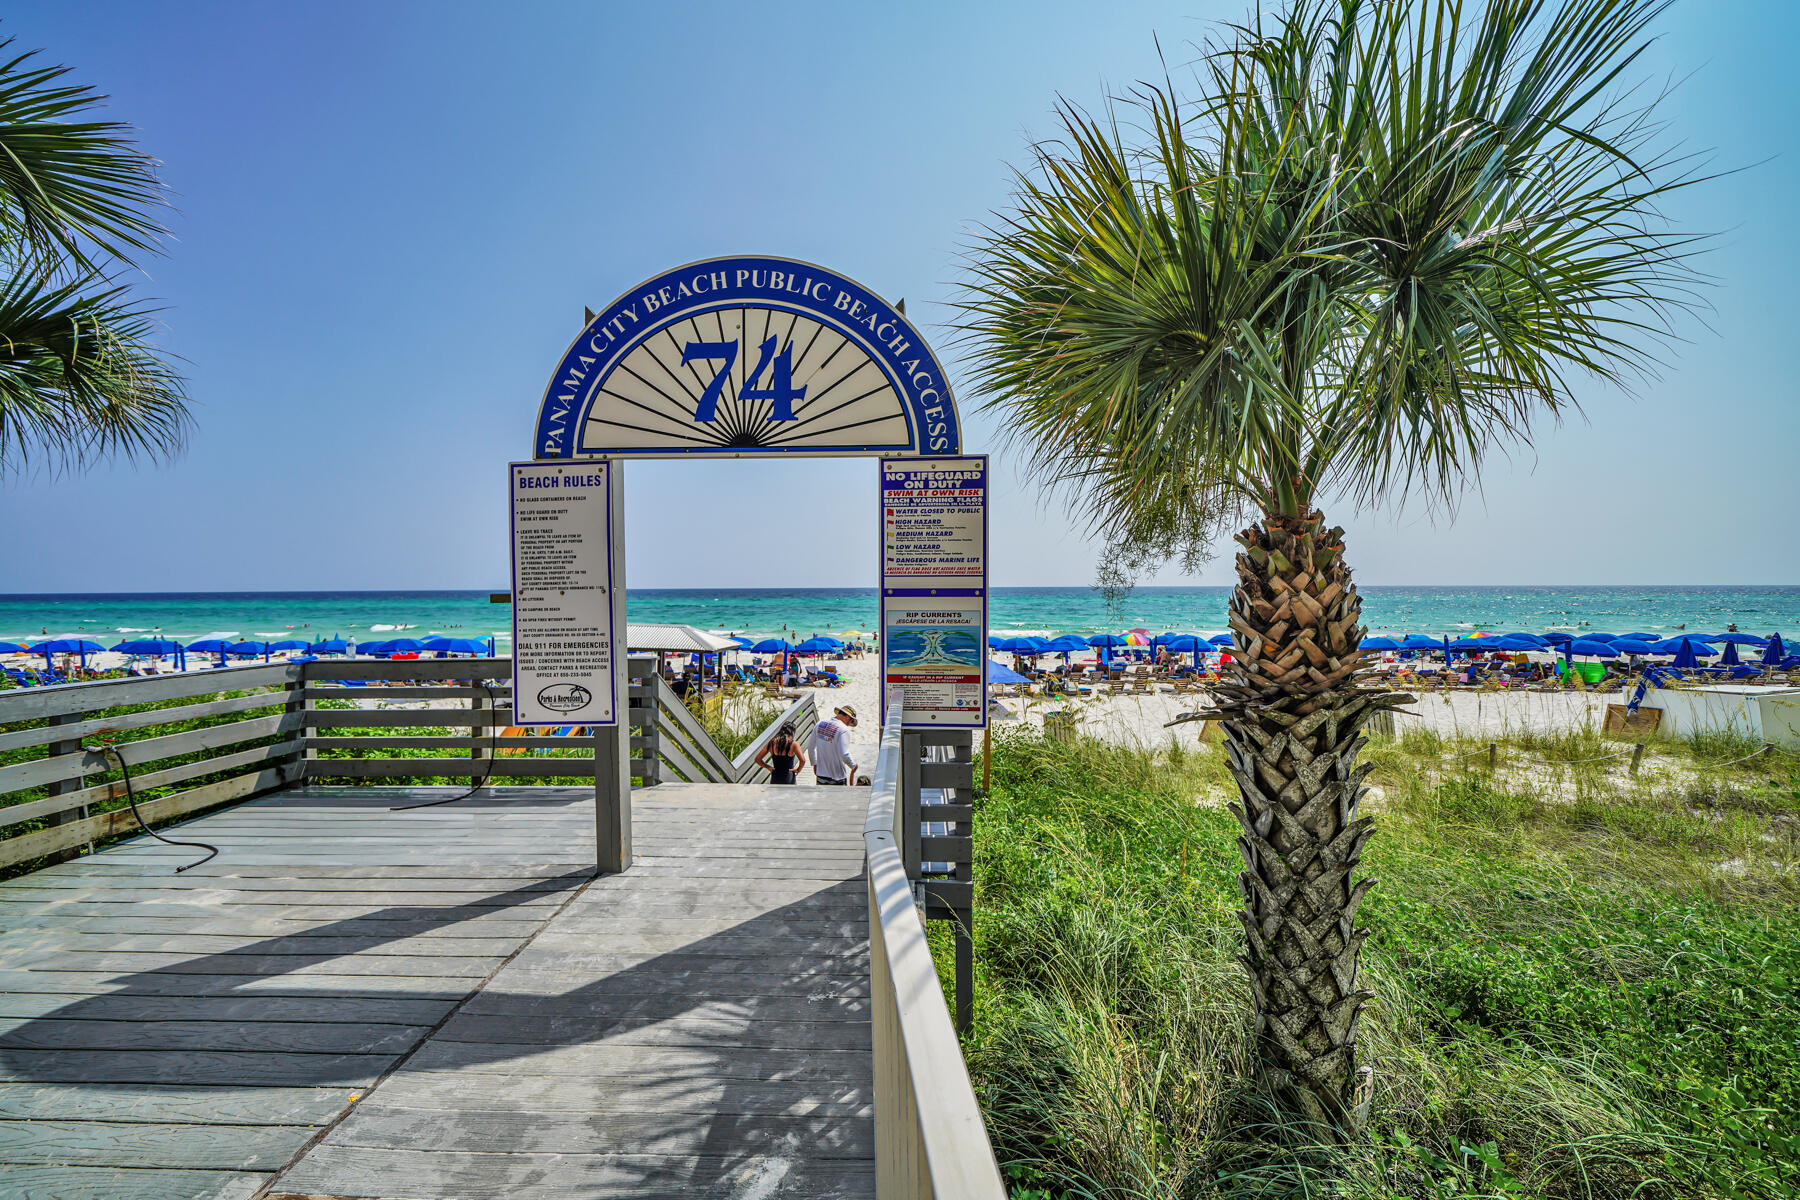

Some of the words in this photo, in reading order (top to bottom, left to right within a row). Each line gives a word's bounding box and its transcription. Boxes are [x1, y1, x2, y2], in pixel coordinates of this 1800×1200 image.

[544, 354, 592, 453] PANAMA
[590, 304, 640, 352] CITY
[643, 271, 728, 313] BEACH
[736, 269, 832, 302] PUBLIC
[833, 290, 912, 356] BEACH
[901, 355, 949, 452] ACCESS
[680, 334, 808, 422] 74
[520, 476, 559, 489] BEACH
[564, 475, 601, 487] RULES
[885, 473, 905, 481] NO
[910, 472, 981, 480] LIFEGUARD
[904, 481, 923, 489] ON
[929, 480, 962, 488] DUTY
